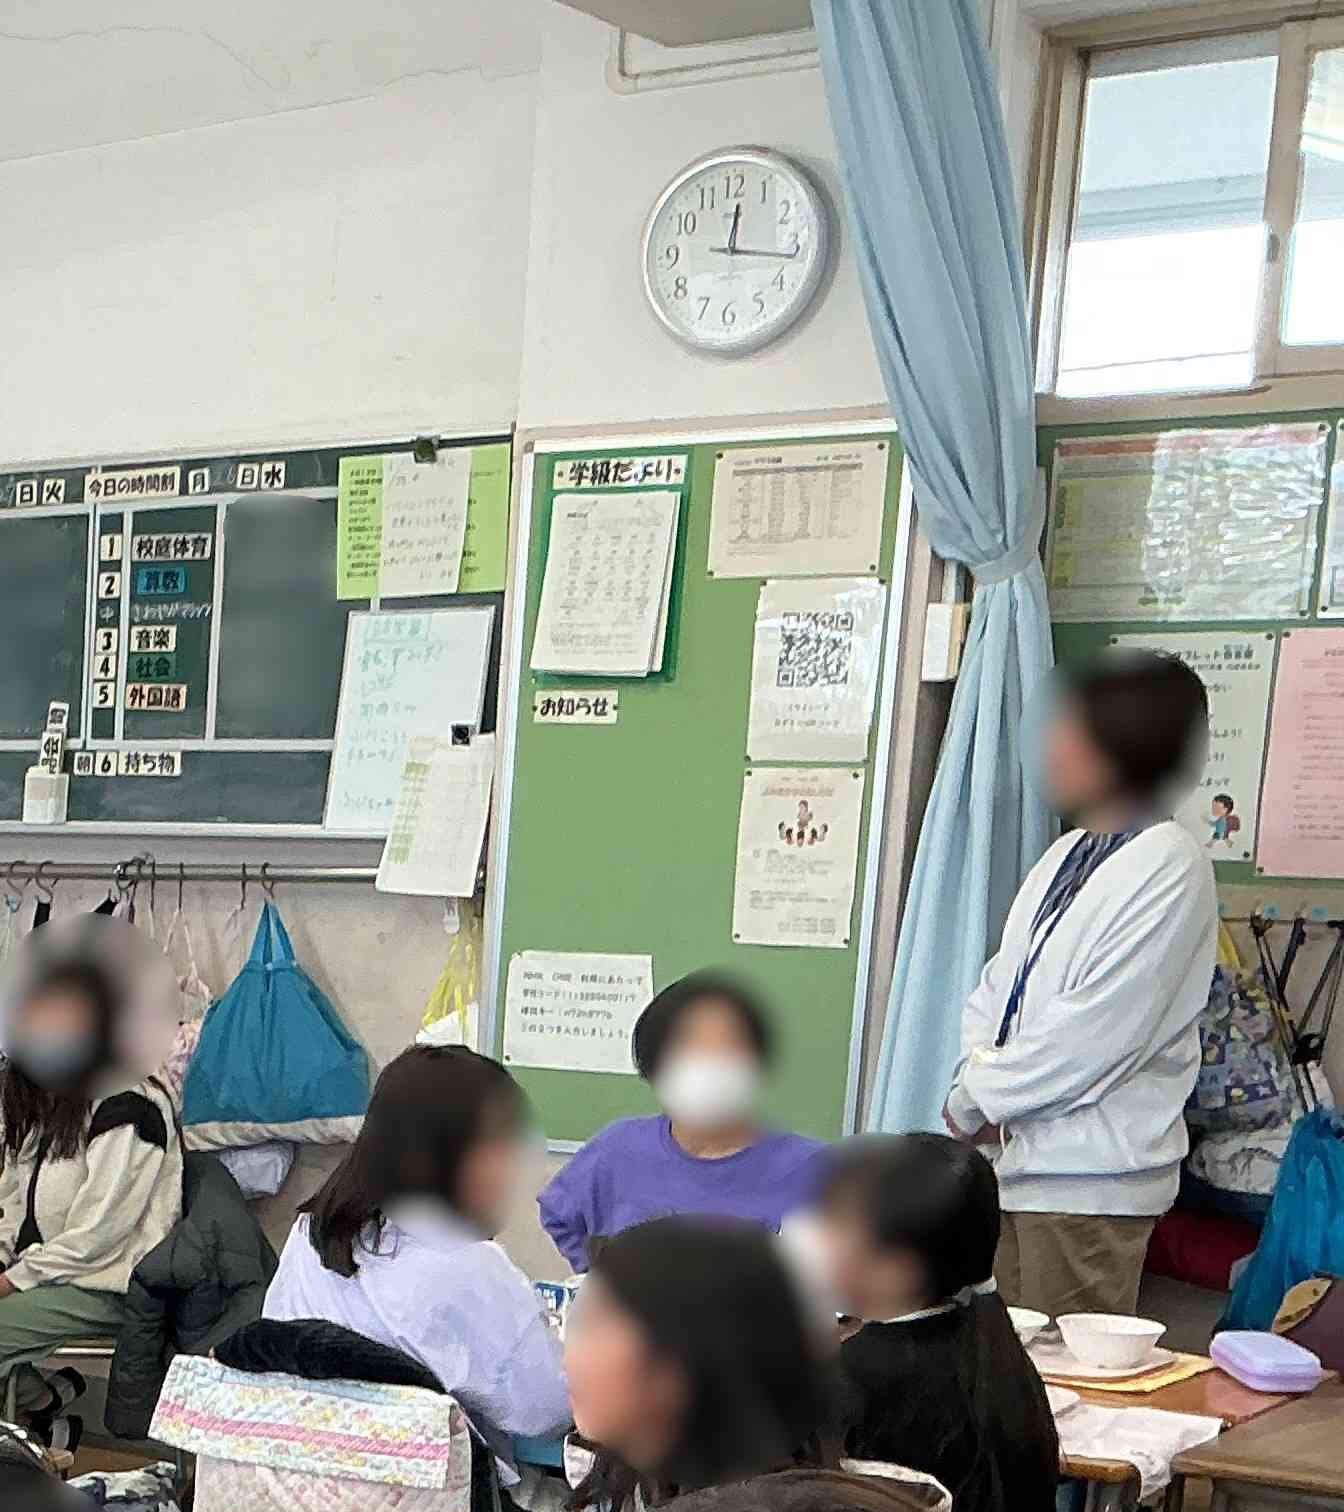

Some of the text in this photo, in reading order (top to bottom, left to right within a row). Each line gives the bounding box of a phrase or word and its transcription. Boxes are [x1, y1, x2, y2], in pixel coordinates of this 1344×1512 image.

[569, 459, 673, 485] 学級だより
[88, 472, 176, 497] 今日の時間割
[109, 538, 114, 557] 1
[136, 536, 208, 559] 校庭体育
[105, 575, 115, 595] 2
[103, 632, 113, 651] 3
[136, 628, 170, 649] 音楽
[101, 659, 110, 677] 4
[135, 658, 171, 677] 社会
[99, 687, 109, 704] 5
[129, 686, 181, 709] 外国語
[540, 696, 608, 716] お知らせ
[100, 756, 111, 773] 6
[124, 752, 176, 774] 持ち物
